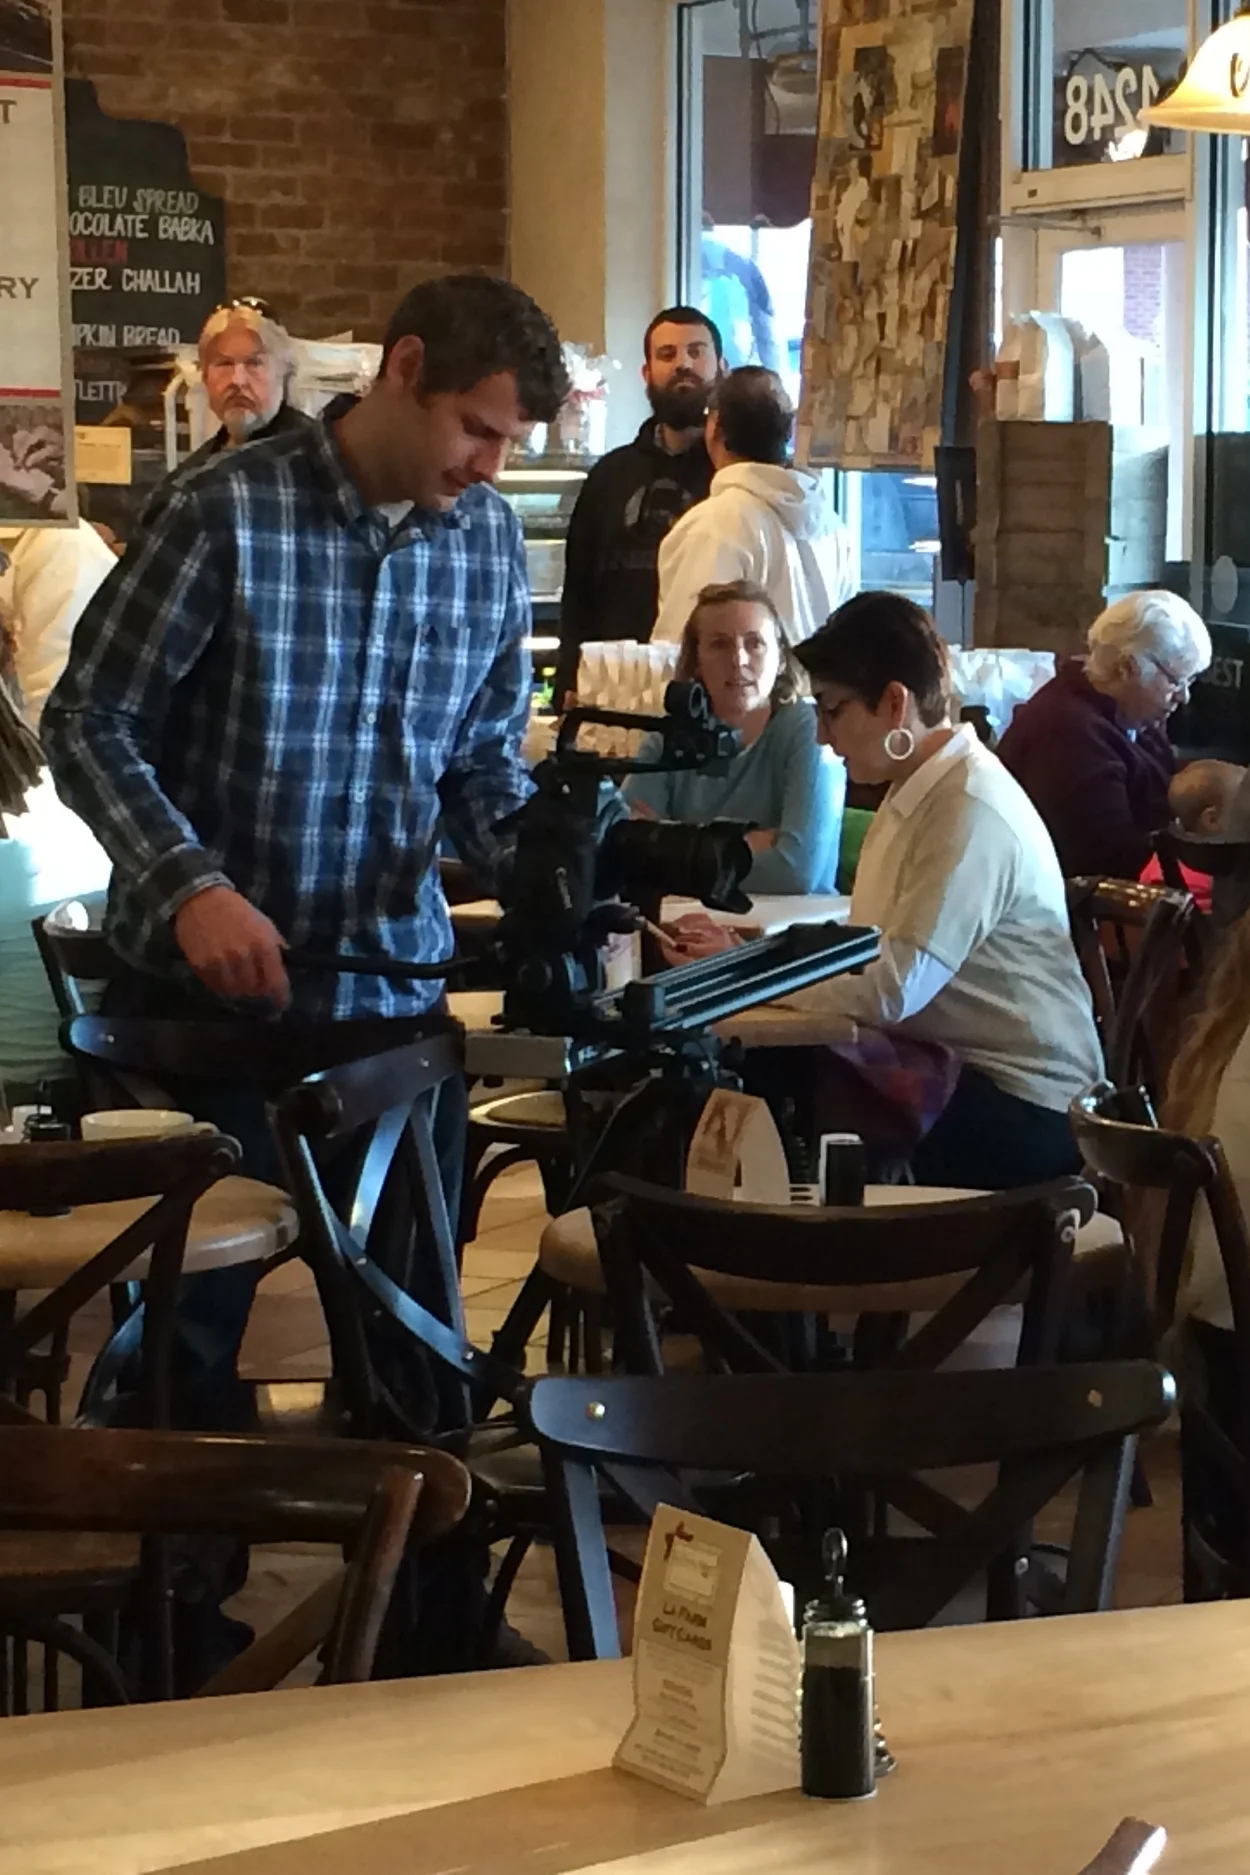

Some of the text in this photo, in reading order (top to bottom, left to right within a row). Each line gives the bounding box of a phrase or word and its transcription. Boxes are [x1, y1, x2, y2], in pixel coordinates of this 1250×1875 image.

[78, 185, 199, 215] BLEU SPREAD
[158, 215, 215, 245] BABKA
[121, 268, 200, 295] CHALLAH
[73, 323, 116, 347] PKIN
